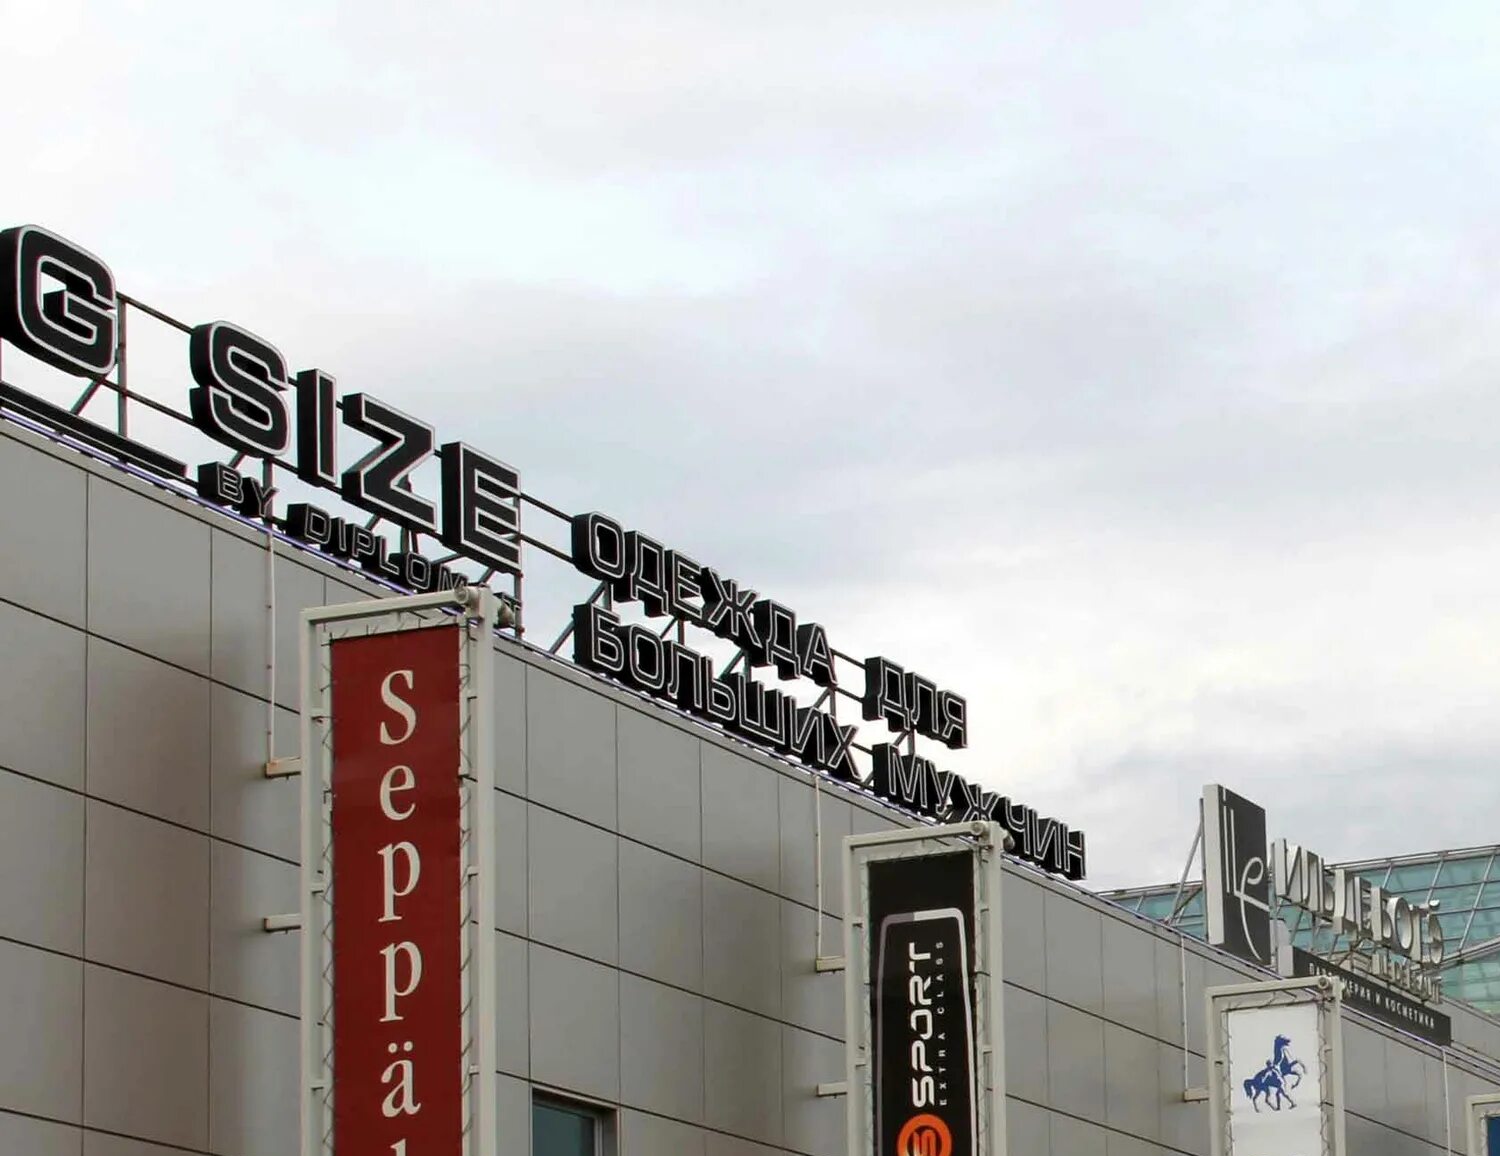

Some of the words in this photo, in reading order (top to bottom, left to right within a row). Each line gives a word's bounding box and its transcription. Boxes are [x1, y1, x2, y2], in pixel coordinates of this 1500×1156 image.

[190, 320, 521, 576] SIZE
[197, 461, 281, 518] BY
[572, 511, 837, 686] ОДЕЖДА
[863, 656, 968, 748] ДЛЯ
[573, 602, 861, 782] БОЛЬШИХ
[873, 742, 1086, 880] МУЖЧИН
[908, 941, 936, 1108] SPORT
[935, 941, 945, 1014] CLASS
[938, 1031, 948, 1106] EXTRA
